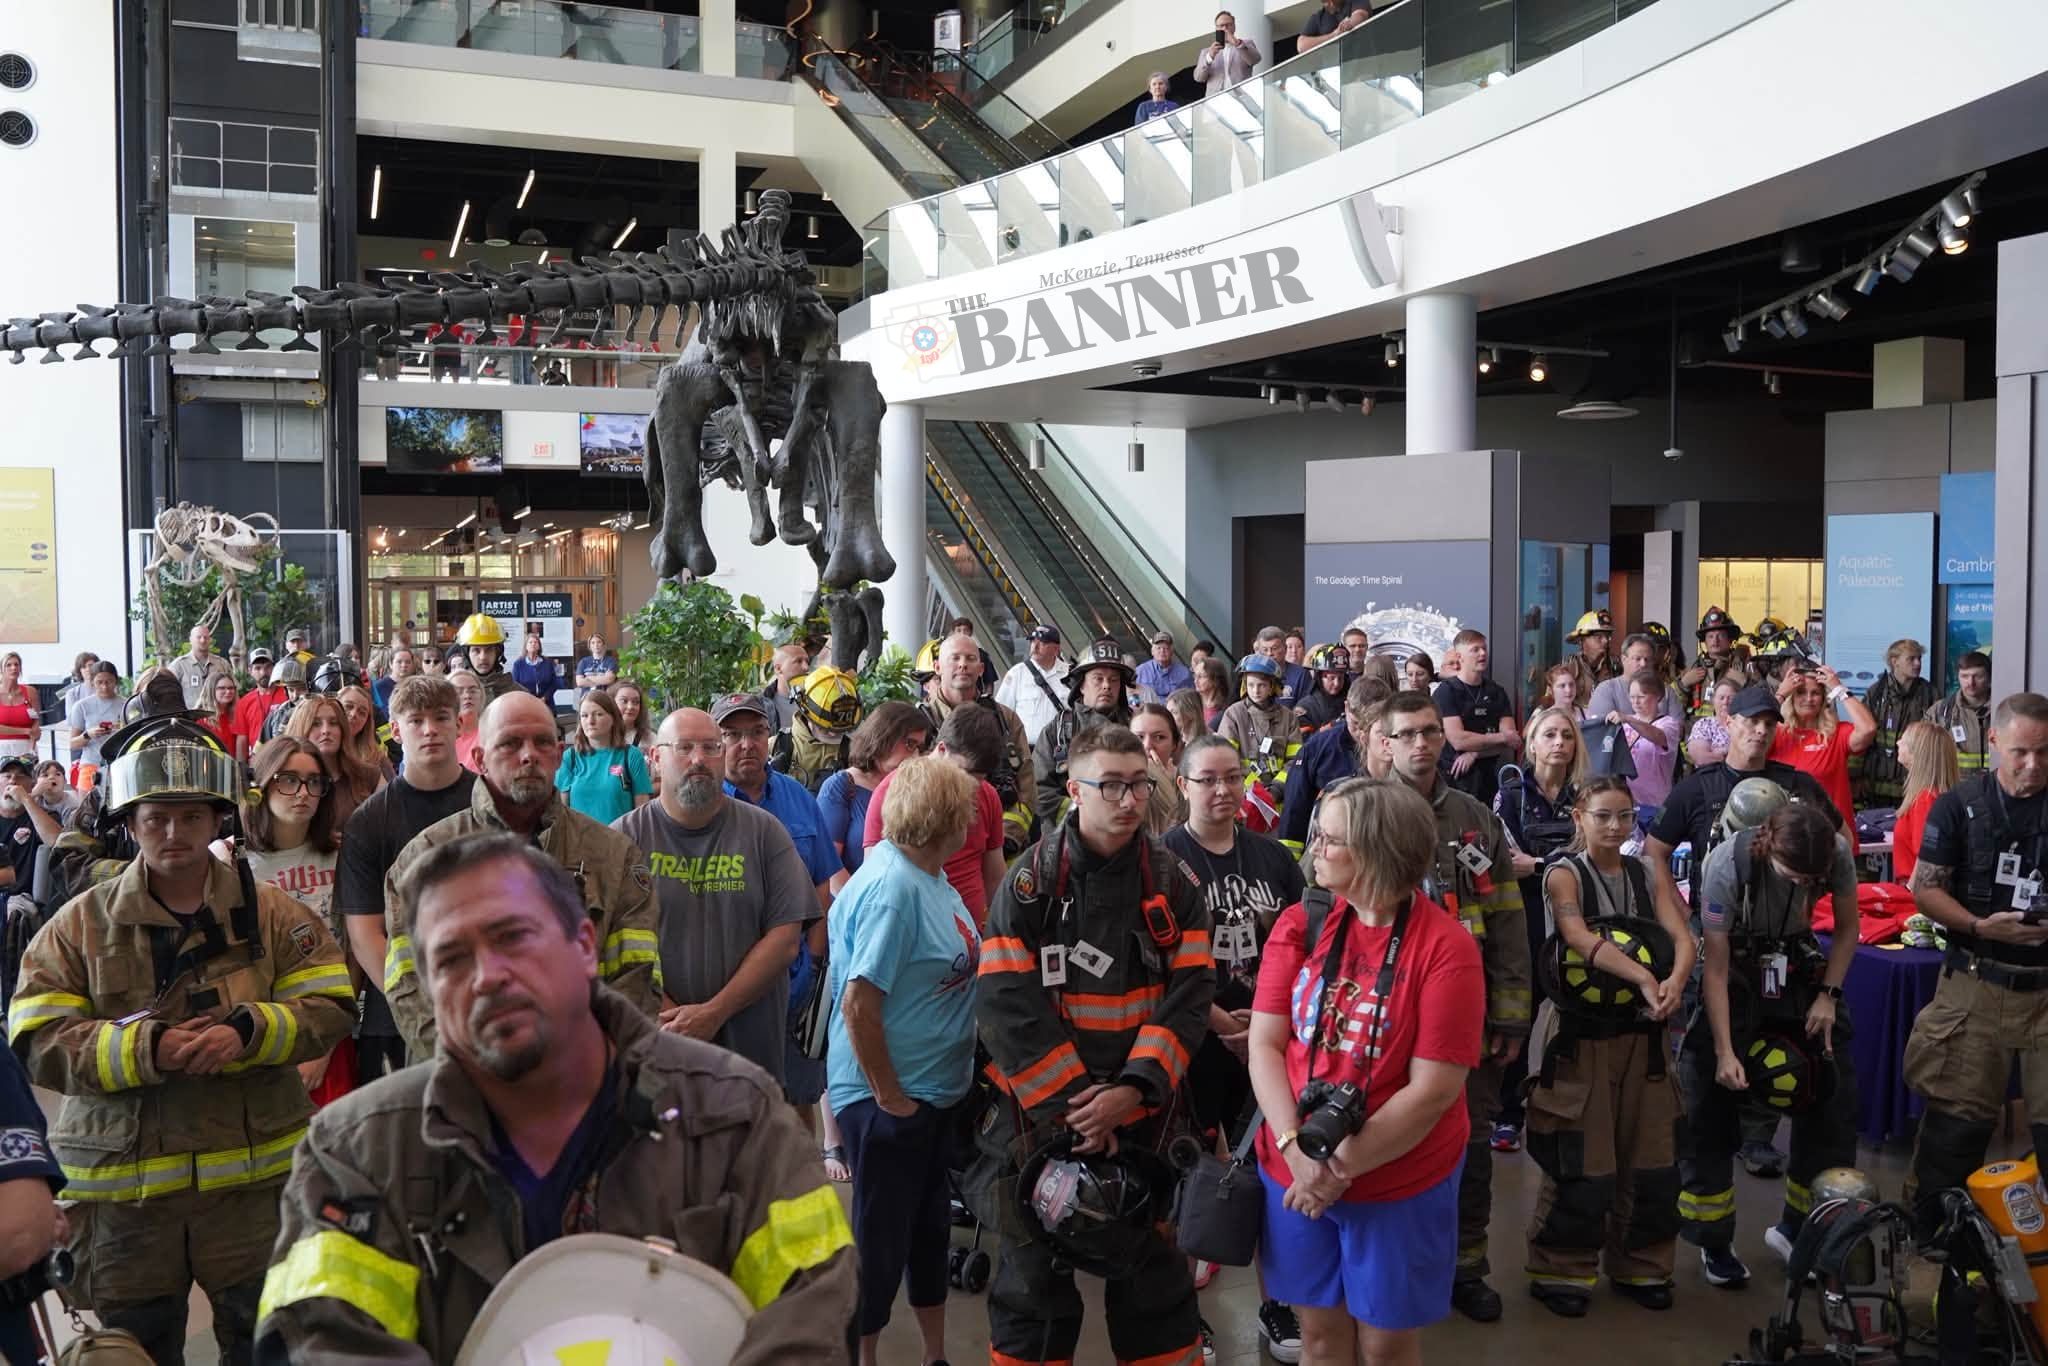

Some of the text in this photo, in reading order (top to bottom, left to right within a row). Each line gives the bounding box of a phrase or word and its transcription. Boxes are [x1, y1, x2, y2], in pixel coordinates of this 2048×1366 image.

[609, 464, 619, 472] To
[1838, 555, 1894, 571] Aquatic
[1315, 576, 1402, 587] The Geologic Time Spiral
[1839, 574, 1904, 586] Paleozoic
[486, 601, 518, 609] ARTIST
[1955, 602, 1969, 613] Age
[1970, 602, 1981, 612] of
[1098, 645, 1118, 659] 511
[650, 852, 744, 882] TRAILERS
